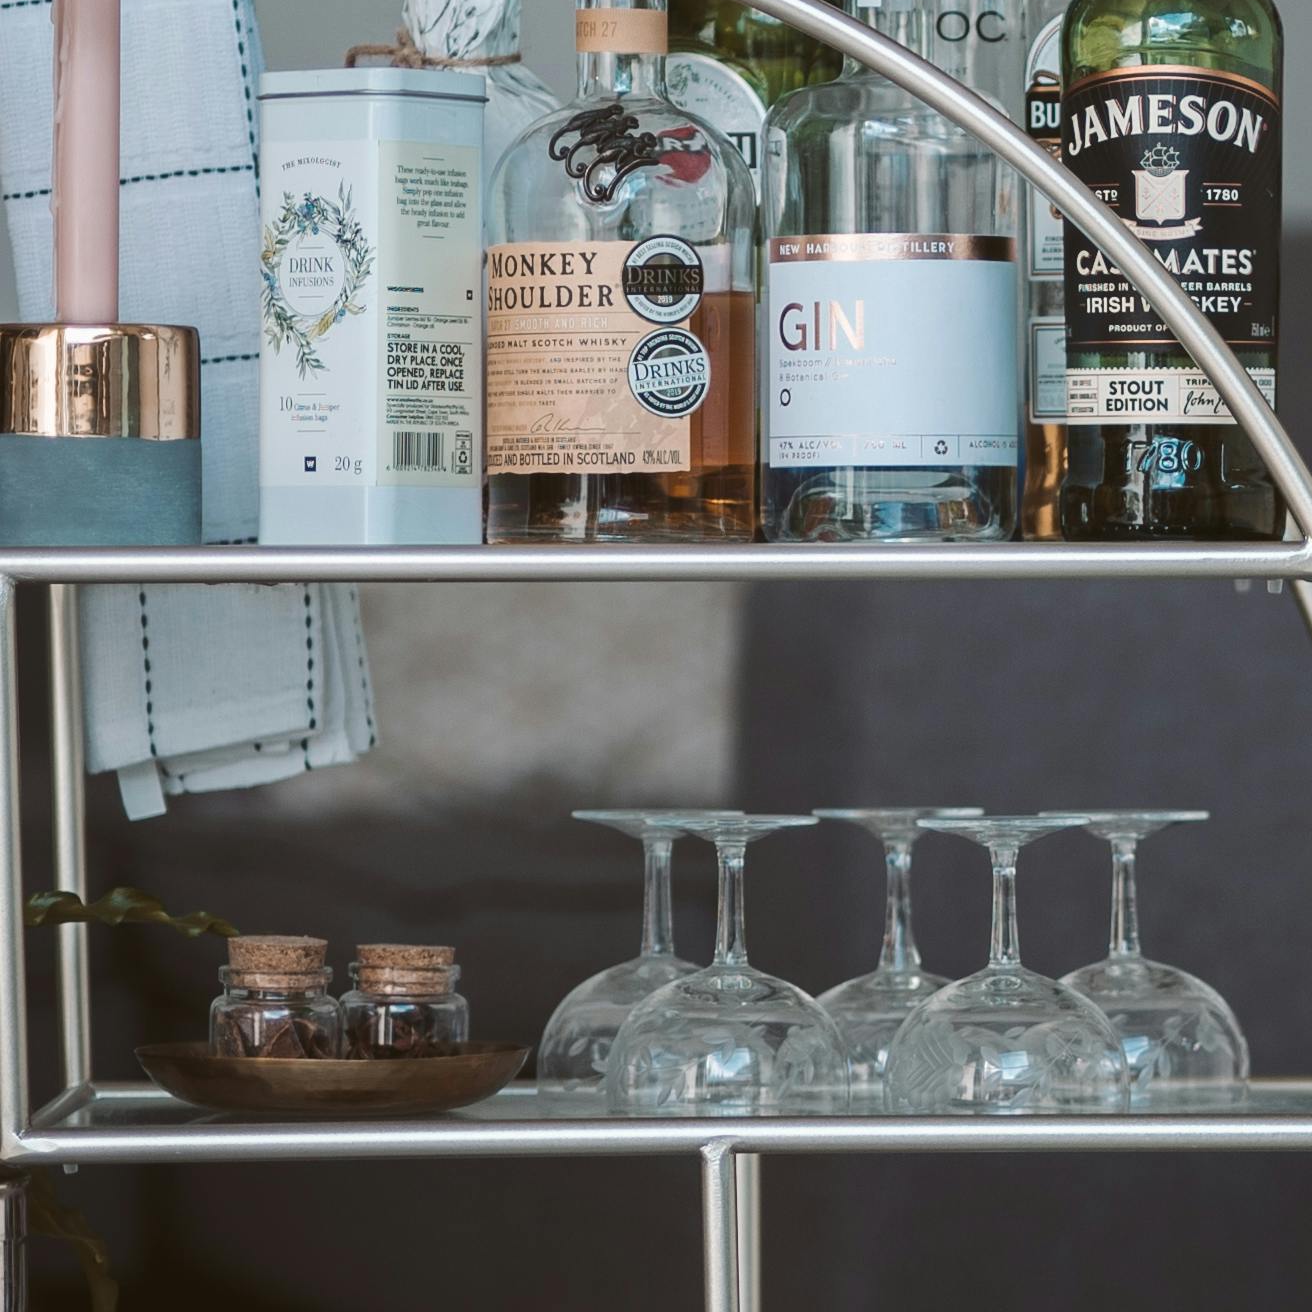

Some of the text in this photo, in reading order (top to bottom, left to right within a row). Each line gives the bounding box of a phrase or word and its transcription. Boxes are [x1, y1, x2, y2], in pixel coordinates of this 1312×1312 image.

[601, 21, 618, 38] 27
[1068, 94, 1264, 156] JAMESON
[1205, 189, 1239, 201] 1780
[779, 244, 800, 255] NEW
[289, 257, 334, 273] DRINK
[492, 252, 598, 279] MONKEY
[289, 276, 334, 287] INFUSIONS
[627, 266, 700, 284] DRINKS
[626, 285, 700, 293] INTERNATIONAL
[1118, 283, 1129, 292] IN
[1207, 282, 1252, 292] BARRELS
[488, 284, 614, 311] SHOULDER
[657, 295, 673, 304] 2019
[1086, 296, 1135, 313] IRISH
[515, 316, 608, 330] SMOOTH AND RICH
[779, 299, 864, 351] GIN
[1108, 324, 1152, 332] PRODUCT
[387, 342, 465, 357] STORE IN A COOL,
[507, 338, 627, 349] MALT SCOTCH WHISKY
[387, 354, 463, 367] DRY PLACE. ONCE
[387, 367, 464, 380] OPENED, REPLACE
[634, 357, 705, 381] DRINKS
[387, 379, 465, 392] TIN LID AFTER USE.
[635, 374, 706, 390] INTERNATIONAL
[1109, 380, 1164, 395] STOUT
[280, 396, 293, 411] 10
[1106, 398, 1168, 412] EDITION
[504, 453, 518, 465] AND
[519, 453, 560, 465] BOTTLED
[563, 452, 573, 465] IN
[577, 451, 636, 465] SCOTLAND
[334, 456, 362, 475] 20 g
